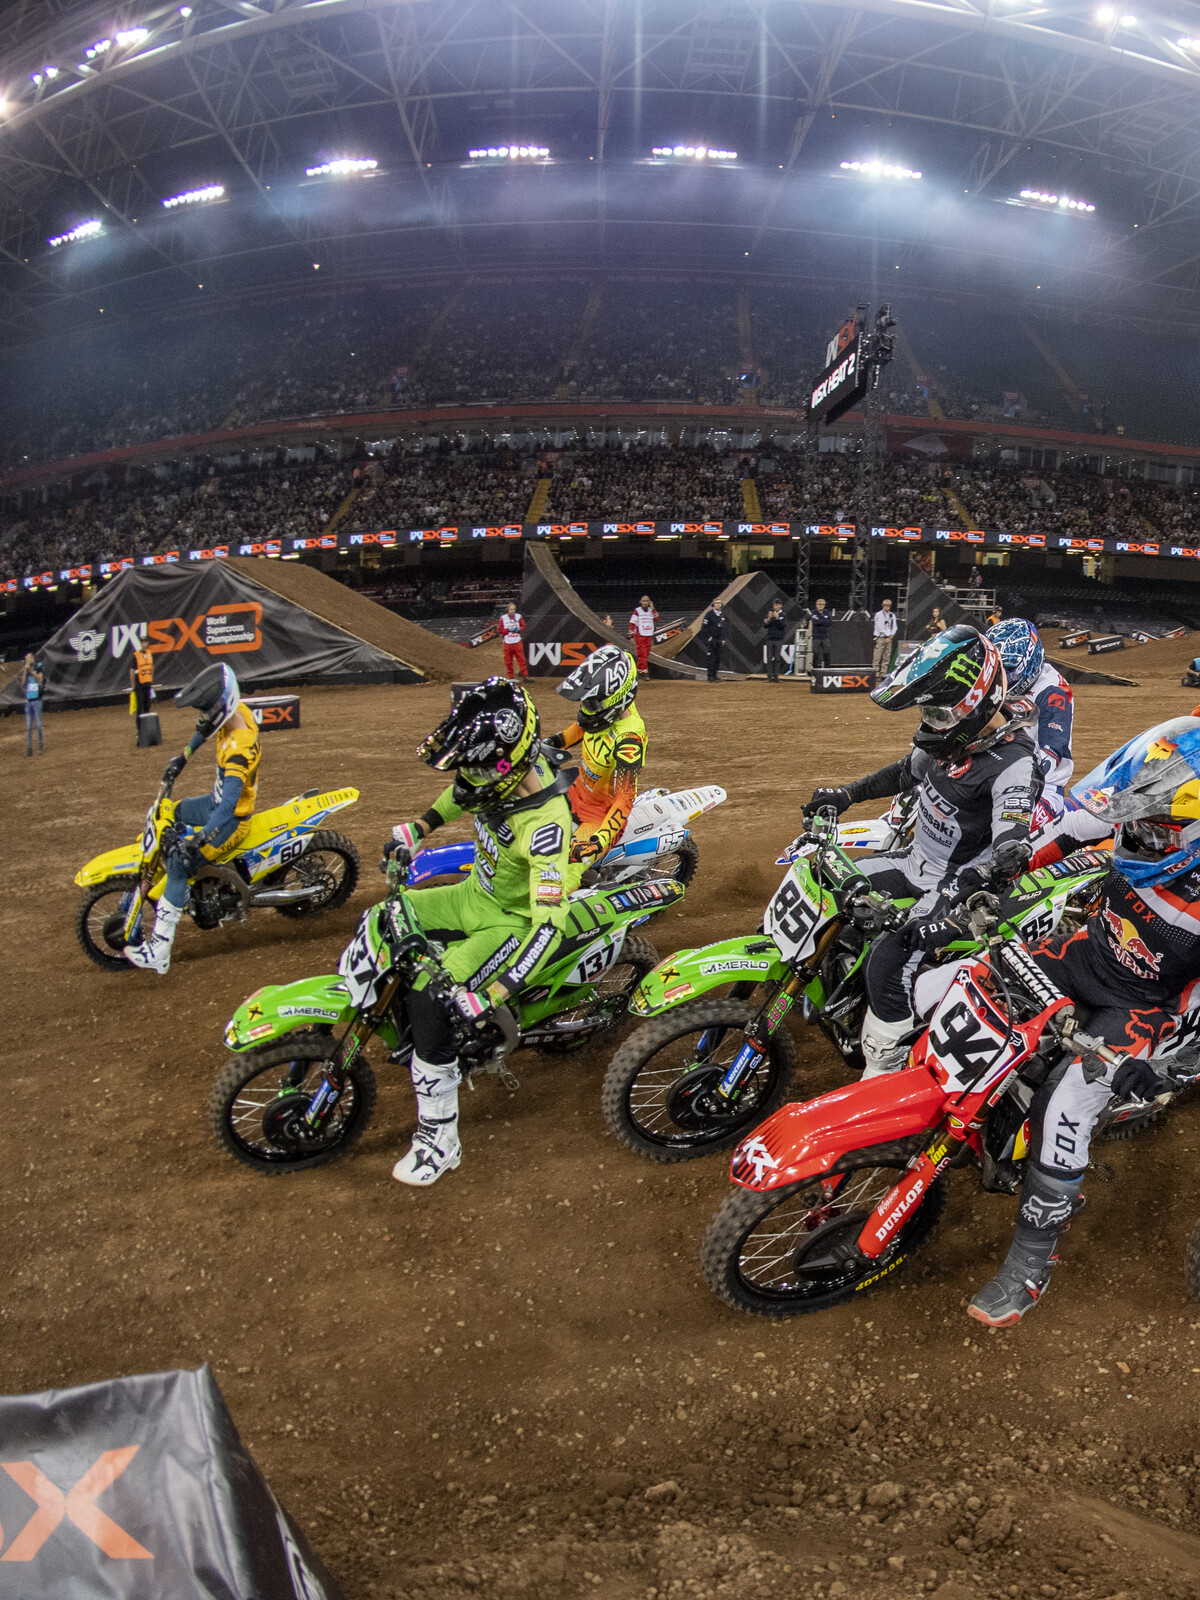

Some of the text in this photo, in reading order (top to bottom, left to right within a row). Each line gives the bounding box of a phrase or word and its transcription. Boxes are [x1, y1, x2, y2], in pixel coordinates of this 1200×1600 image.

[848, 352, 856, 376] 2
[206, 616, 226, 626] World
[206, 624, 244, 636] Supercross
[112, 615, 208, 658] WSX
[206, 632, 254, 644] Championship
[656, 627, 681, 643] WSX
[1066, 632, 1088, 646] WSX
[823, 676, 870, 688] WSX
[1005, 798, 1030, 807] BS
[280, 840, 302, 866] 60
[656, 830, 685, 856] 65
[774, 880, 819, 944] 85
[1125, 892, 1156, 923] FOX
[920, 922, 947, 937] FOX
[1022, 908, 1054, 943] 85
[577, 943, 615, 984] 137
[718, 961, 769, 971] MERLO
[294, 1008, 340, 1018] MERLO
[929, 1000, 1004, 1086] 94
[728, 1046, 750, 1082] MICHELIN
[1056, 1112, 1081, 1170] FOX
[876, 1180, 924, 1242] DUNLOP
[856, 1255, 905, 1291] DUNLOP
